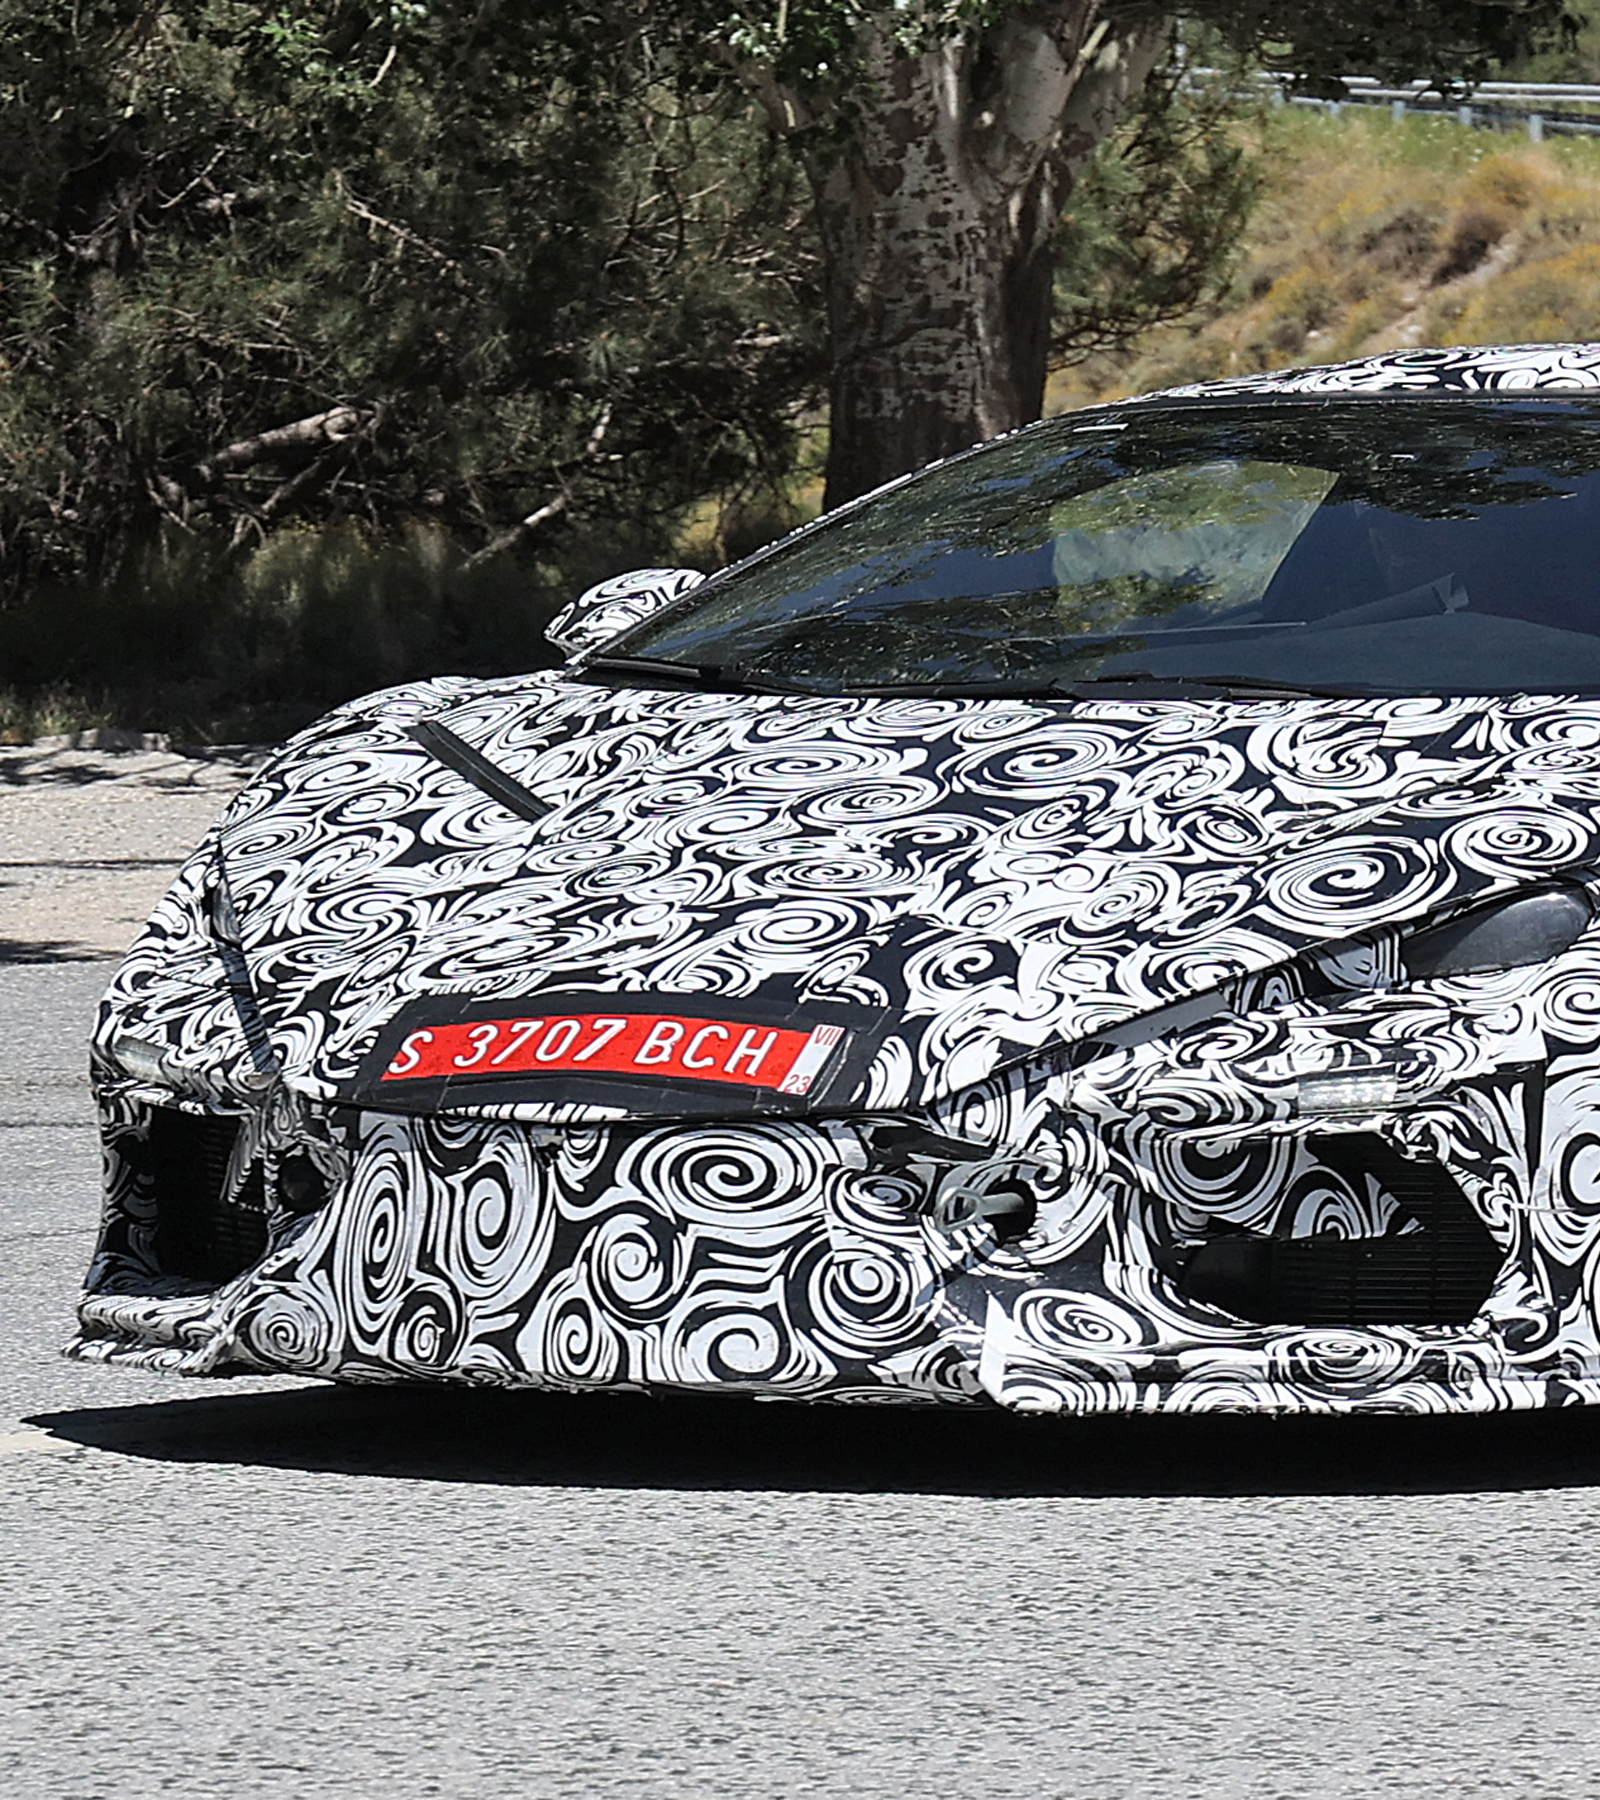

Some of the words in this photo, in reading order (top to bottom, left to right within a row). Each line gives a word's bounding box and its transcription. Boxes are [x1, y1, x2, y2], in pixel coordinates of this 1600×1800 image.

[387, 1029, 435, 1075] S
[452, 1017, 628, 1068] 3707
[632, 1019, 779, 1077] BCH
[813, 1025, 842, 1047] VII
[783, 1073, 812, 1094] 23
